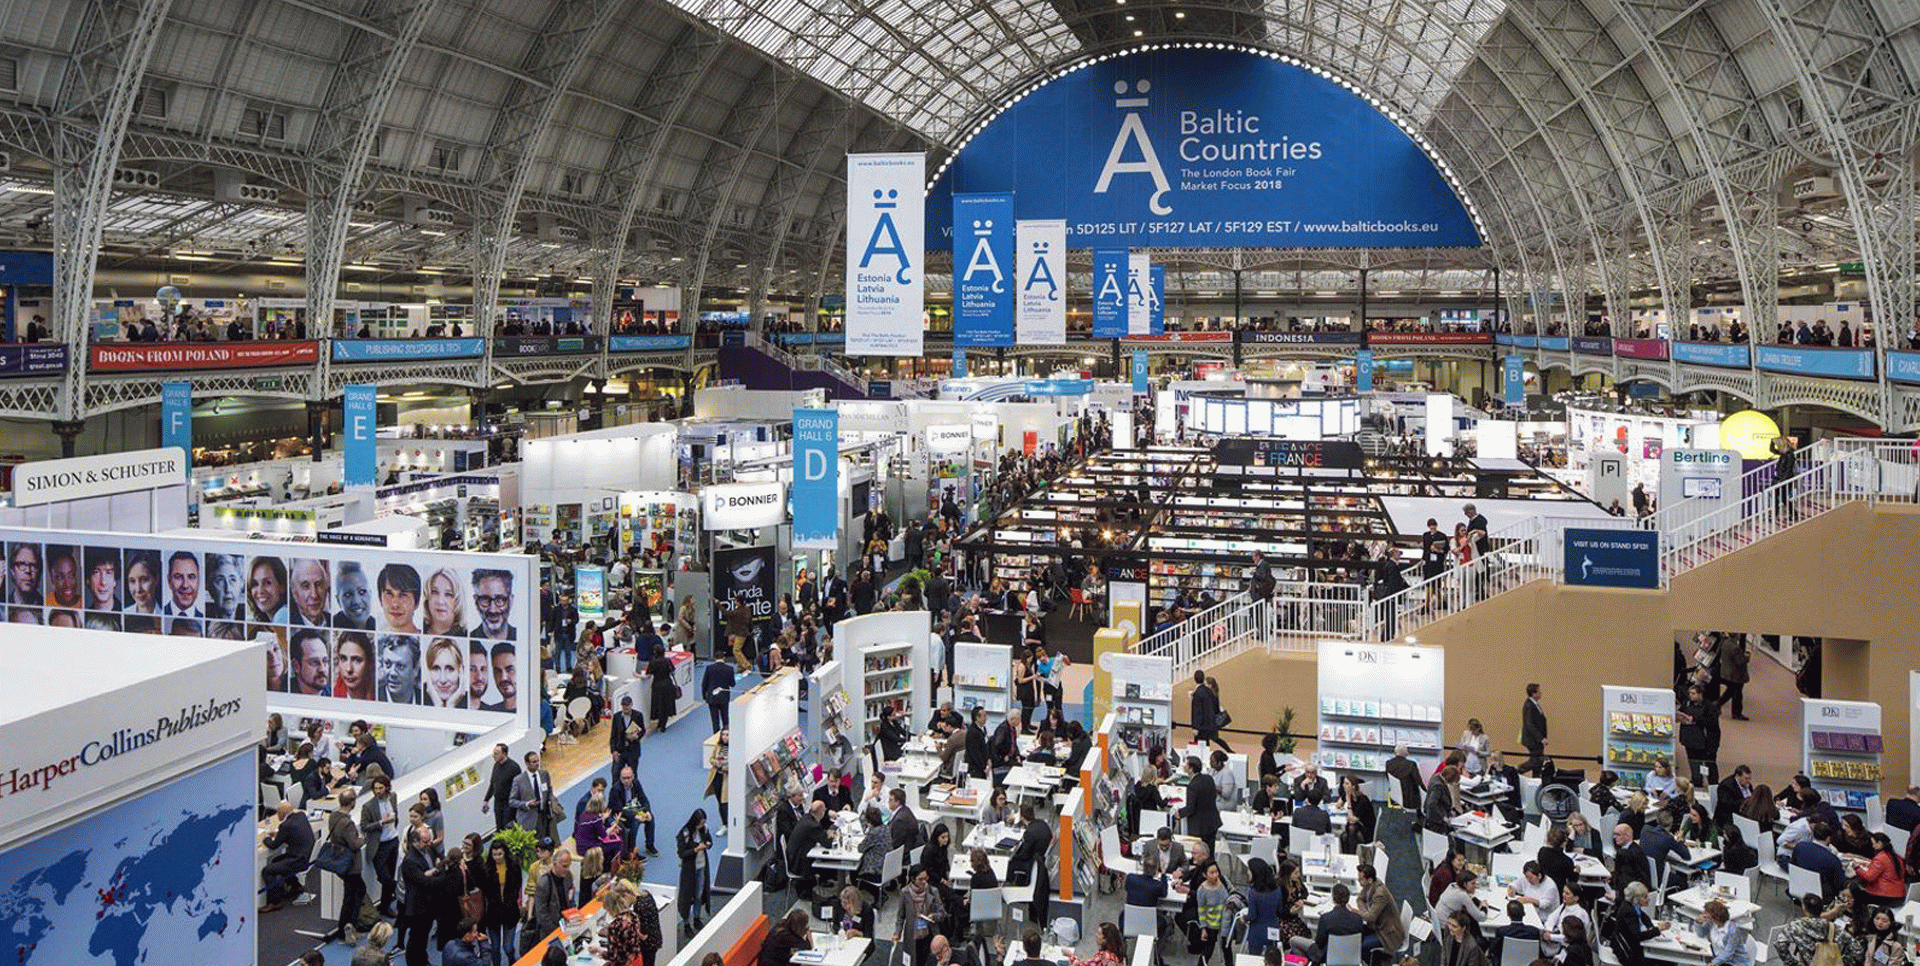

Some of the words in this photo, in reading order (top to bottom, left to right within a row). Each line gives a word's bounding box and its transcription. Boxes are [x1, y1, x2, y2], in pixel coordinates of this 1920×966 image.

[1180, 108, 1260, 134] Baltic
[1179, 135, 1322, 162] Countries
[1180, 168, 1199, 178] The
[1203, 167, 1243, 178] London
[1245, 167, 1272, 177] Book
[1275, 166, 1297, 177] Fair
[1180, 181, 1217, 191] Market
[1220, 180, 1252, 190] Focus
[1254, 180, 1282, 190] 2018
[1076, 223, 1116, 235] 5D125
[1119, 222, 1137, 234] LIT
[1139, 222, 1146, 234] /
[1148, 222, 1185, 234] 5F127
[1188, 221, 1213, 233] LAT
[1214, 221, 1221, 233] /
[1224, 221, 1263, 233] 5F129
[1266, 221, 1292, 232] EST
[1293, 220, 1300, 233] /
[1303, 220, 1439, 233] www.balticbooks.eu
[857, 273, 892, 282] Estonia
[857, 284, 885, 293] Latvia
[857, 294, 900, 304] Lithuania
[962, 292, 984, 300] Latvia
[962, 300, 996, 308] Lithuania
[1255, 333, 1314, 344] INDONESIA
[365, 344, 402, 354] PUBLISHING
[404, 344, 438, 354] SOLUTIONS
[98, 351, 143, 363] BOOKS
[147, 350, 184, 362] FROM
[185, 349, 230, 362] POLAND
[1136, 363, 1144, 375] D
[1360, 362, 1369, 374] C
[1510, 369, 1519, 382] B
[165, 390, 189, 398] GRAND
[348, 393, 374, 401] GRAND
[348, 402, 365, 410] HALL
[366, 402, 373, 410] 6
[172, 411, 183, 435] F
[354, 415, 367, 440] E
[798, 418, 834, 430] GRAND
[799, 431, 823, 441] HALL
[825, 431, 832, 442] 6
[1270, 452, 1323, 467] FRANCE
[1673, 451, 1730, 464] Bertline
[805, 449, 827, 480] D
[1606, 465, 1615, 474] P
[26, 471, 83, 492] SIMON
[85, 470, 98, 484] &
[101, 460, 176, 482] SCHUSTER
[729, 493, 778, 507] BONNIER
[1573, 540, 1588, 548] VISIT
[1599, 541, 1609, 549] ON
[718, 598, 771, 620] Plnte
[1821, 706, 1840, 718] DK
